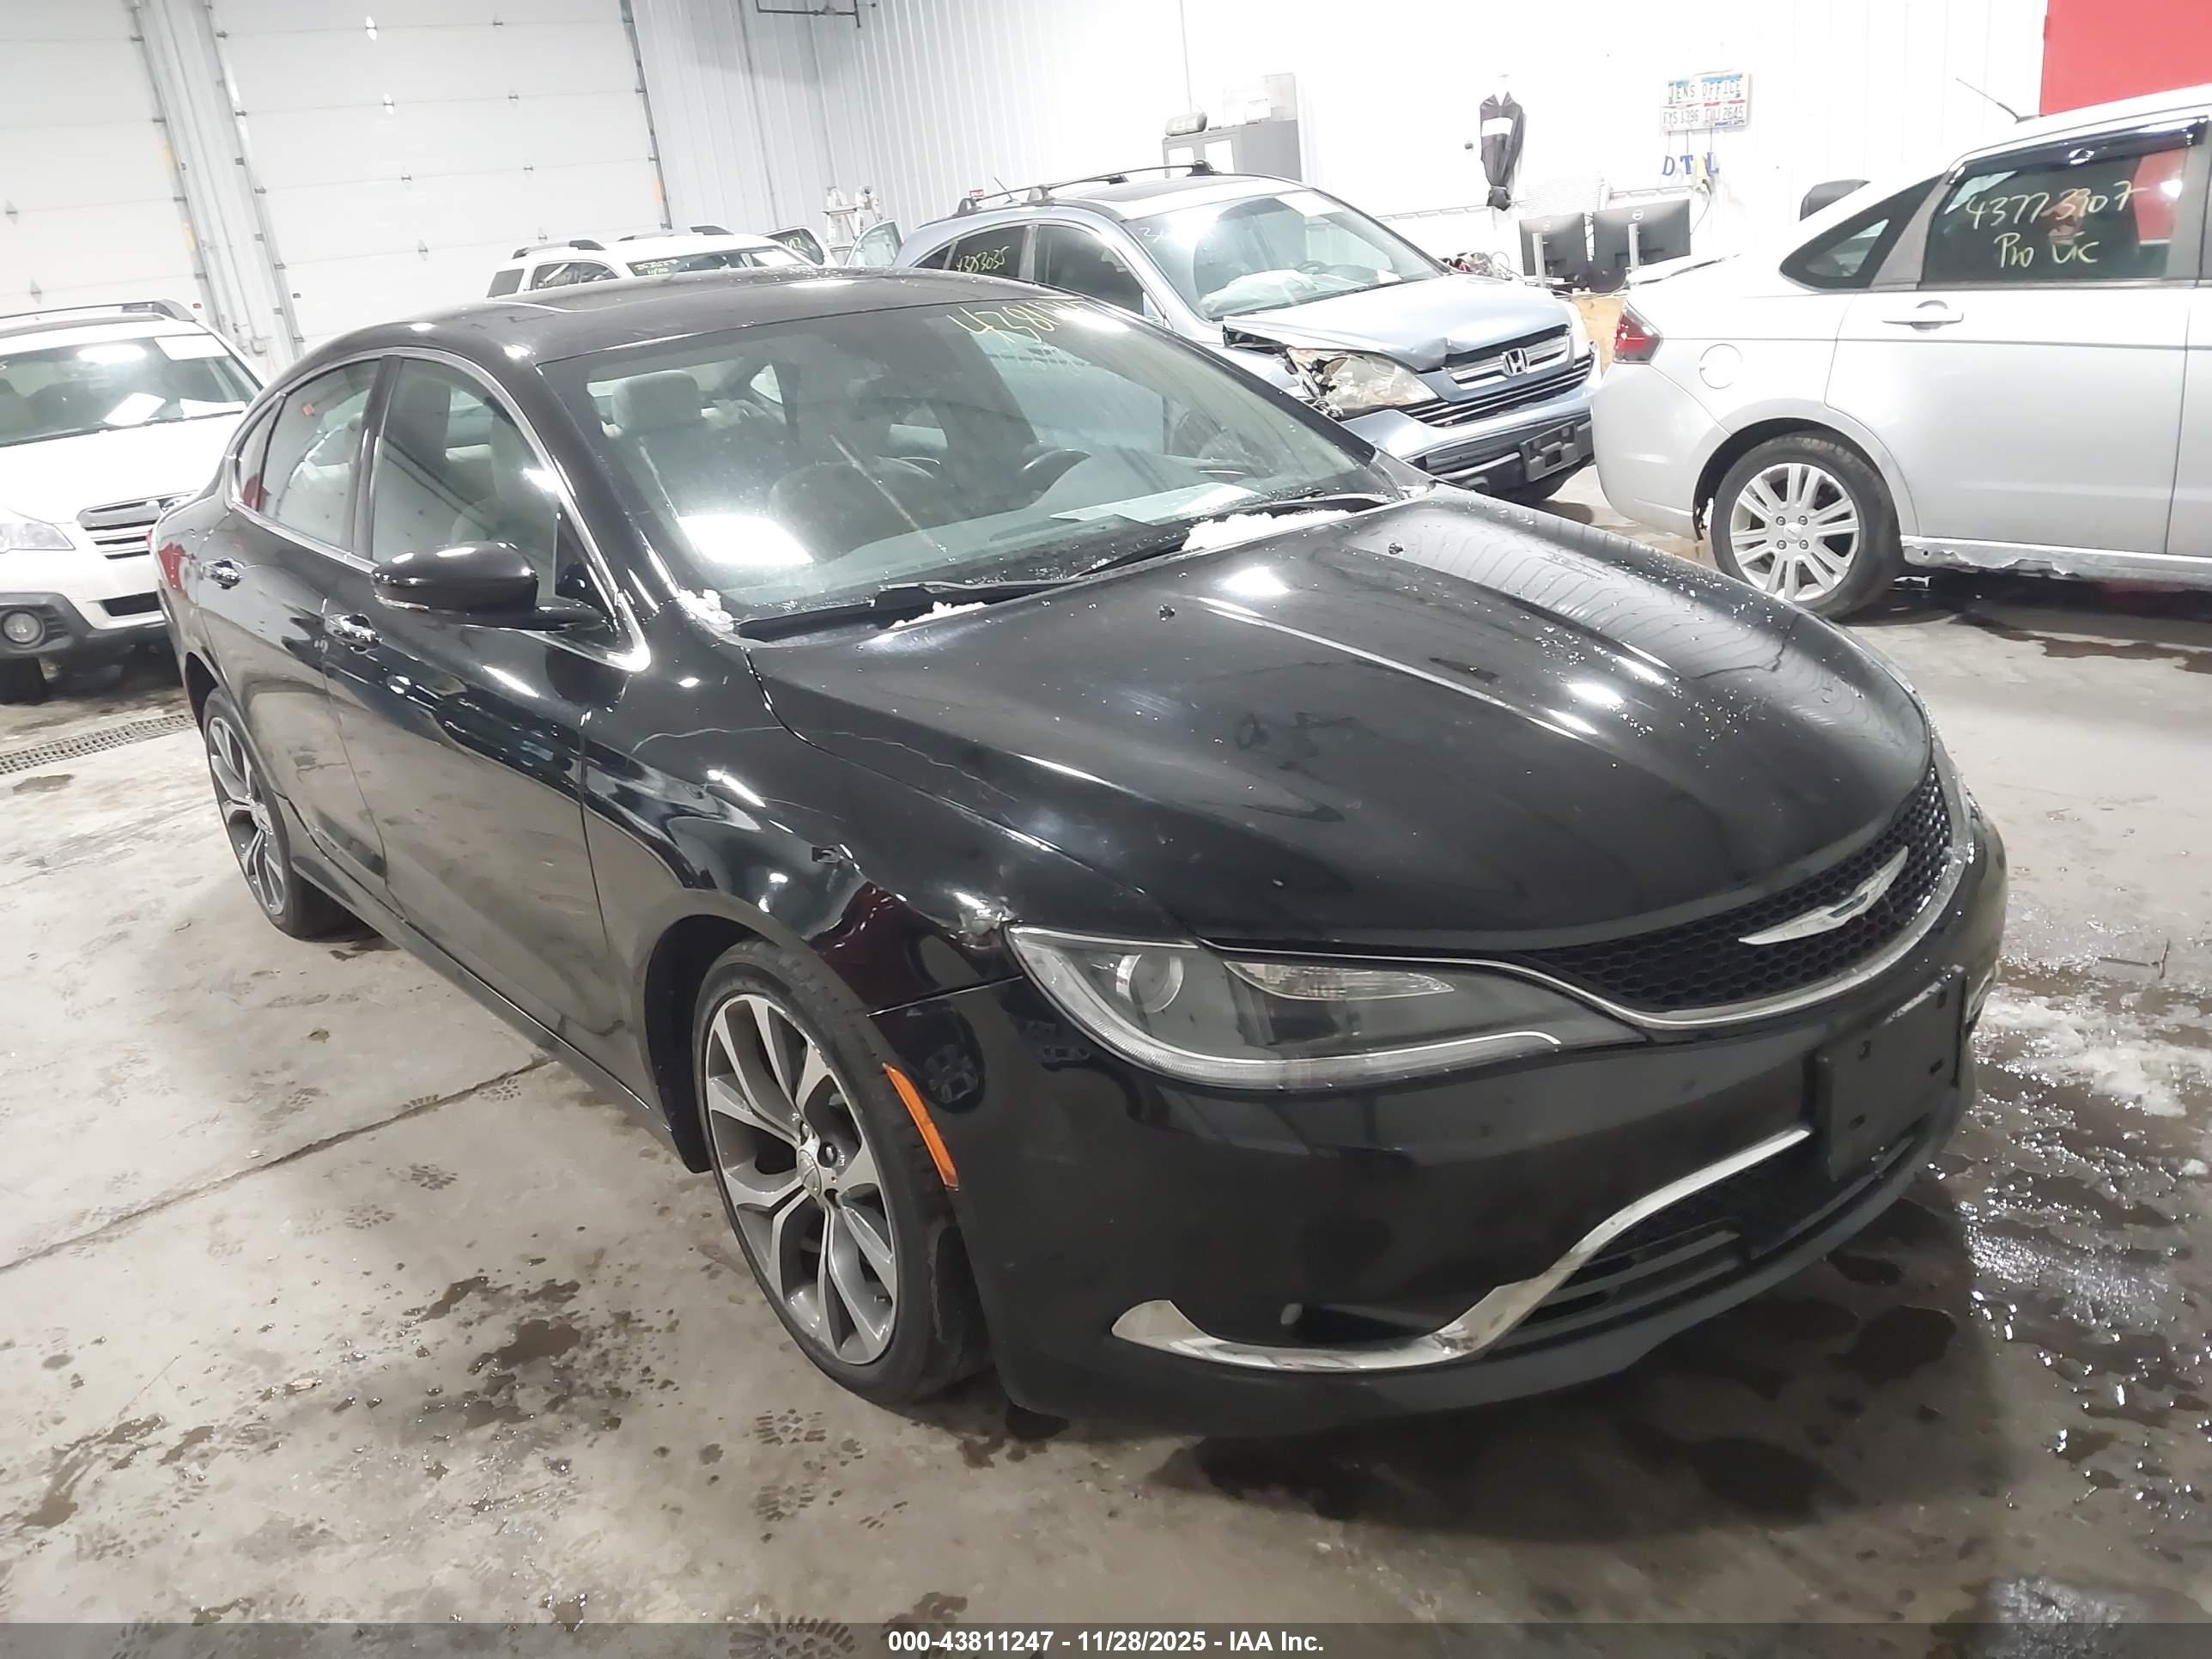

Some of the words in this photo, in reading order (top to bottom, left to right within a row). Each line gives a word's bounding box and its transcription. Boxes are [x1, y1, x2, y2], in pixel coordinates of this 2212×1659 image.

[1668, 83, 1696, 99] JENS
[1702, 79, 1741, 97] OFFICE
[1662, 155, 1675, 176] D
[1680, 154, 1694, 174] T
